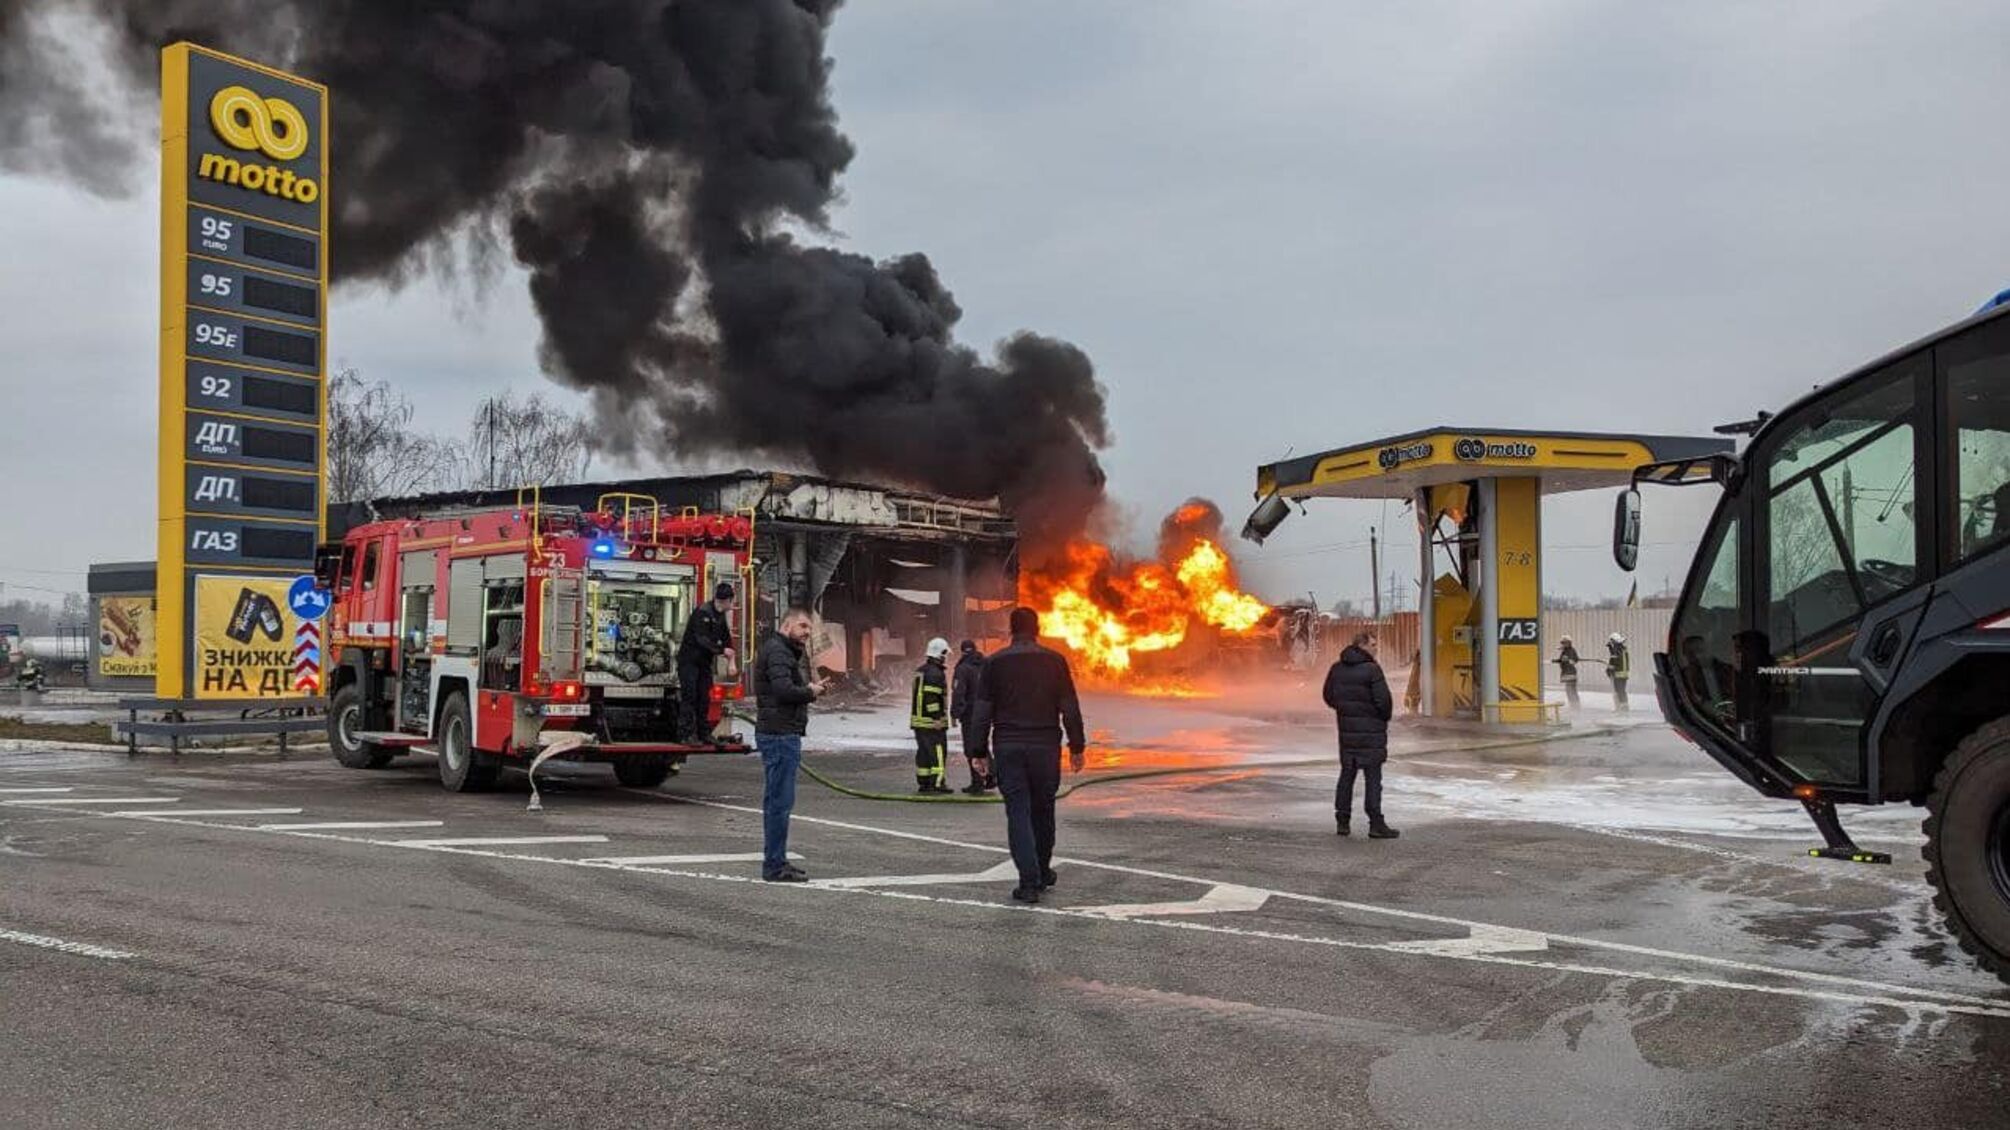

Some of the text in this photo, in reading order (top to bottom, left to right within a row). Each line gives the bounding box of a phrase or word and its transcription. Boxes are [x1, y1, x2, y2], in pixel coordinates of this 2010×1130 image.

[199, 153, 318, 203] motto
[200, 217, 233, 240] 95
[200, 274, 232, 296] 95
[200, 376, 231, 398] 92
[1487, 443, 1537, 458] motto
[191, 530, 239, 551] ГАЗ
[1499, 621, 1537, 640] ГАЗ
[203, 668, 248, 692] НА
